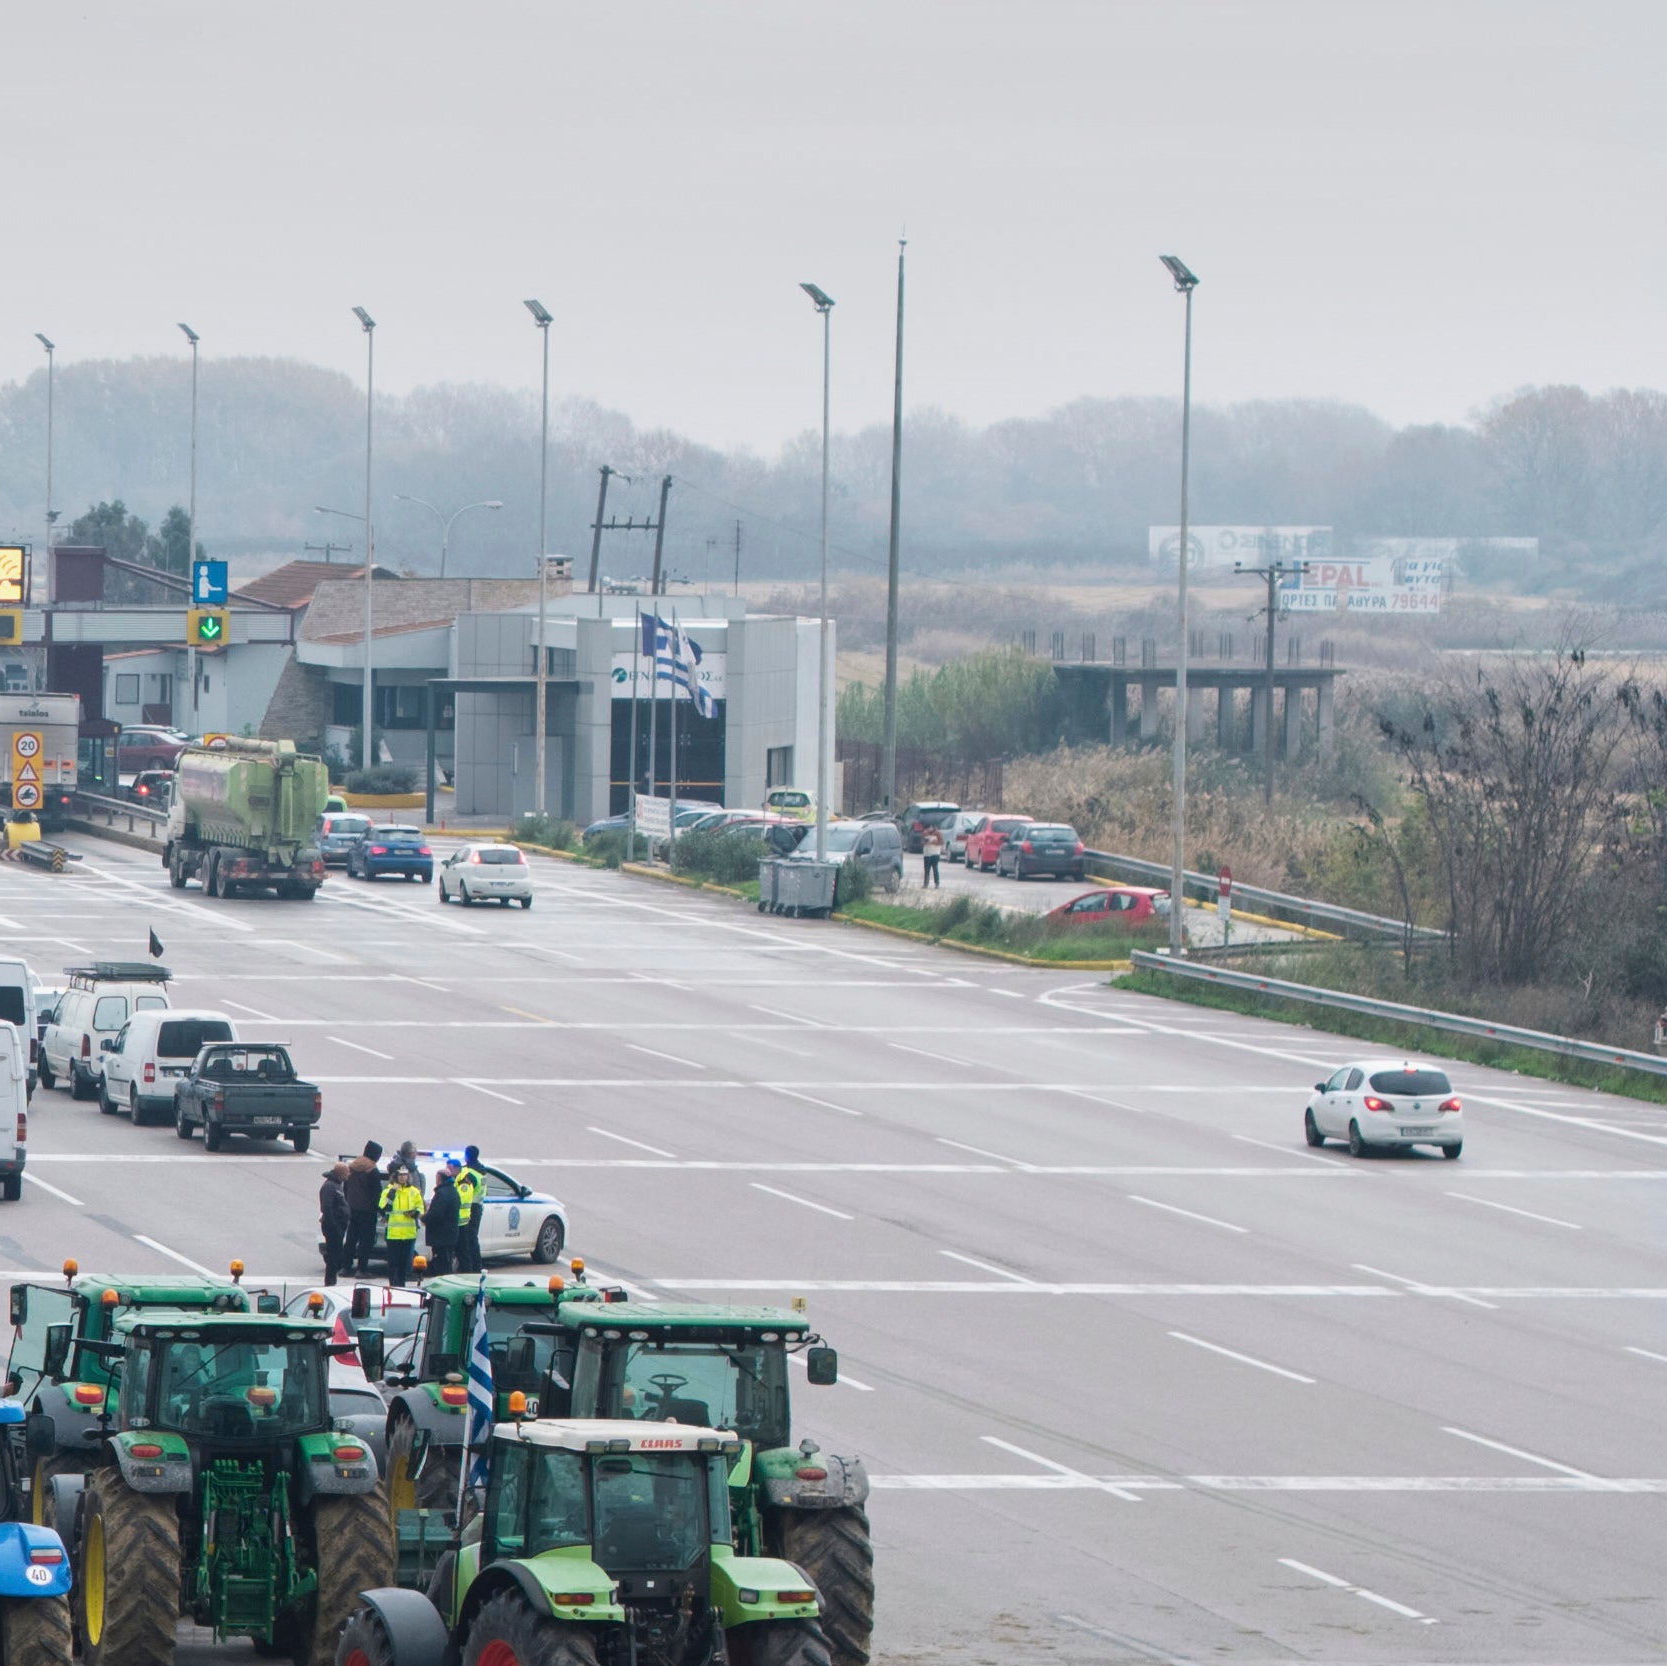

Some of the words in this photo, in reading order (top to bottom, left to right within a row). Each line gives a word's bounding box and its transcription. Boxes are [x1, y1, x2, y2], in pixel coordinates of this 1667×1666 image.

[1282, 594, 1317, 608] ΟΡΤΕΣ
[21, 741, 35, 751] 20
[640, 1439, 683, 1449] CLAAS
[31, 1568, 47, 1581] 40
